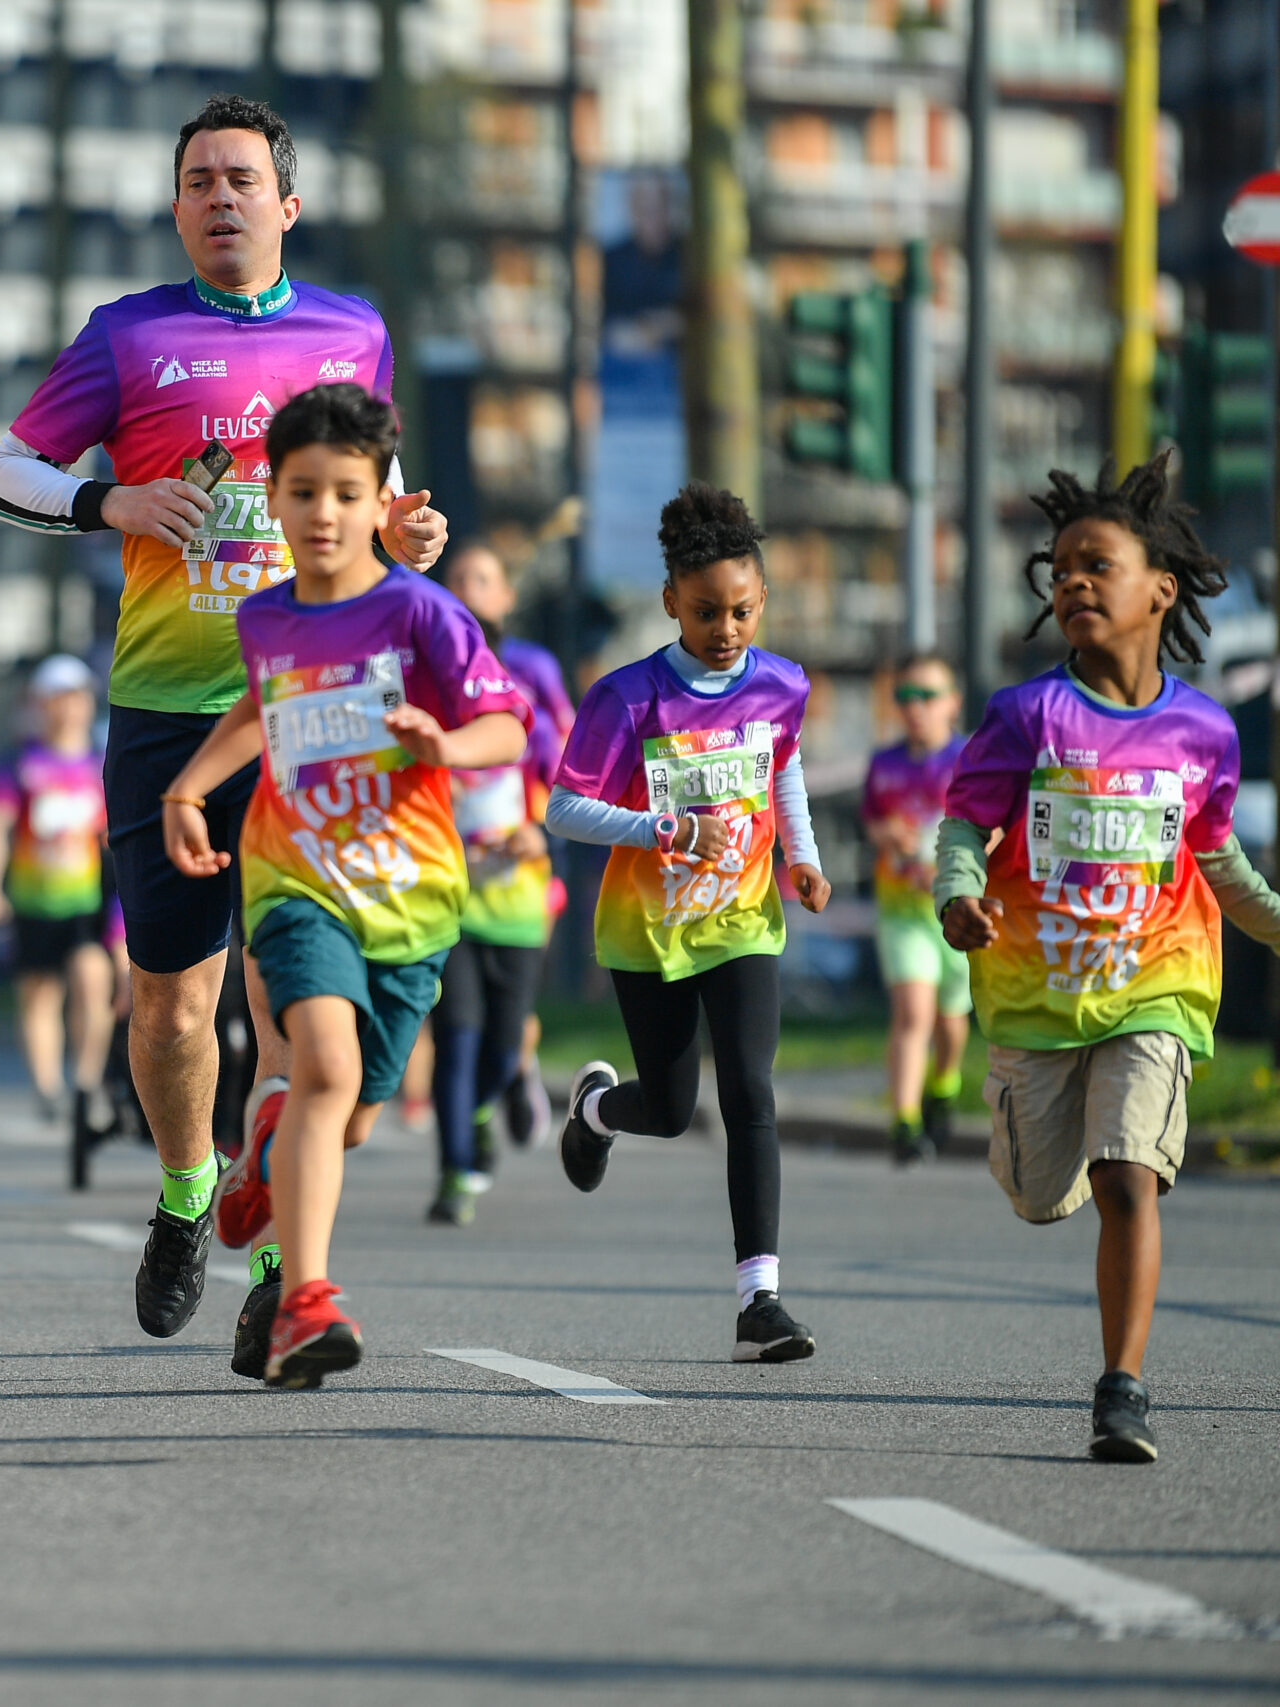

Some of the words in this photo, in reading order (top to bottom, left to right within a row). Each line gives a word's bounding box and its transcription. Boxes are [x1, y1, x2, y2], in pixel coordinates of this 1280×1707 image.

[215, 492, 283, 532] 273
[193, 595, 220, 611] ALL
[684, 759, 743, 798] 3163
[1070, 808, 1147, 852] 3162
[717, 847, 745, 873] &
[658, 863, 740, 914] Play
[1036, 910, 1144, 991] Play
